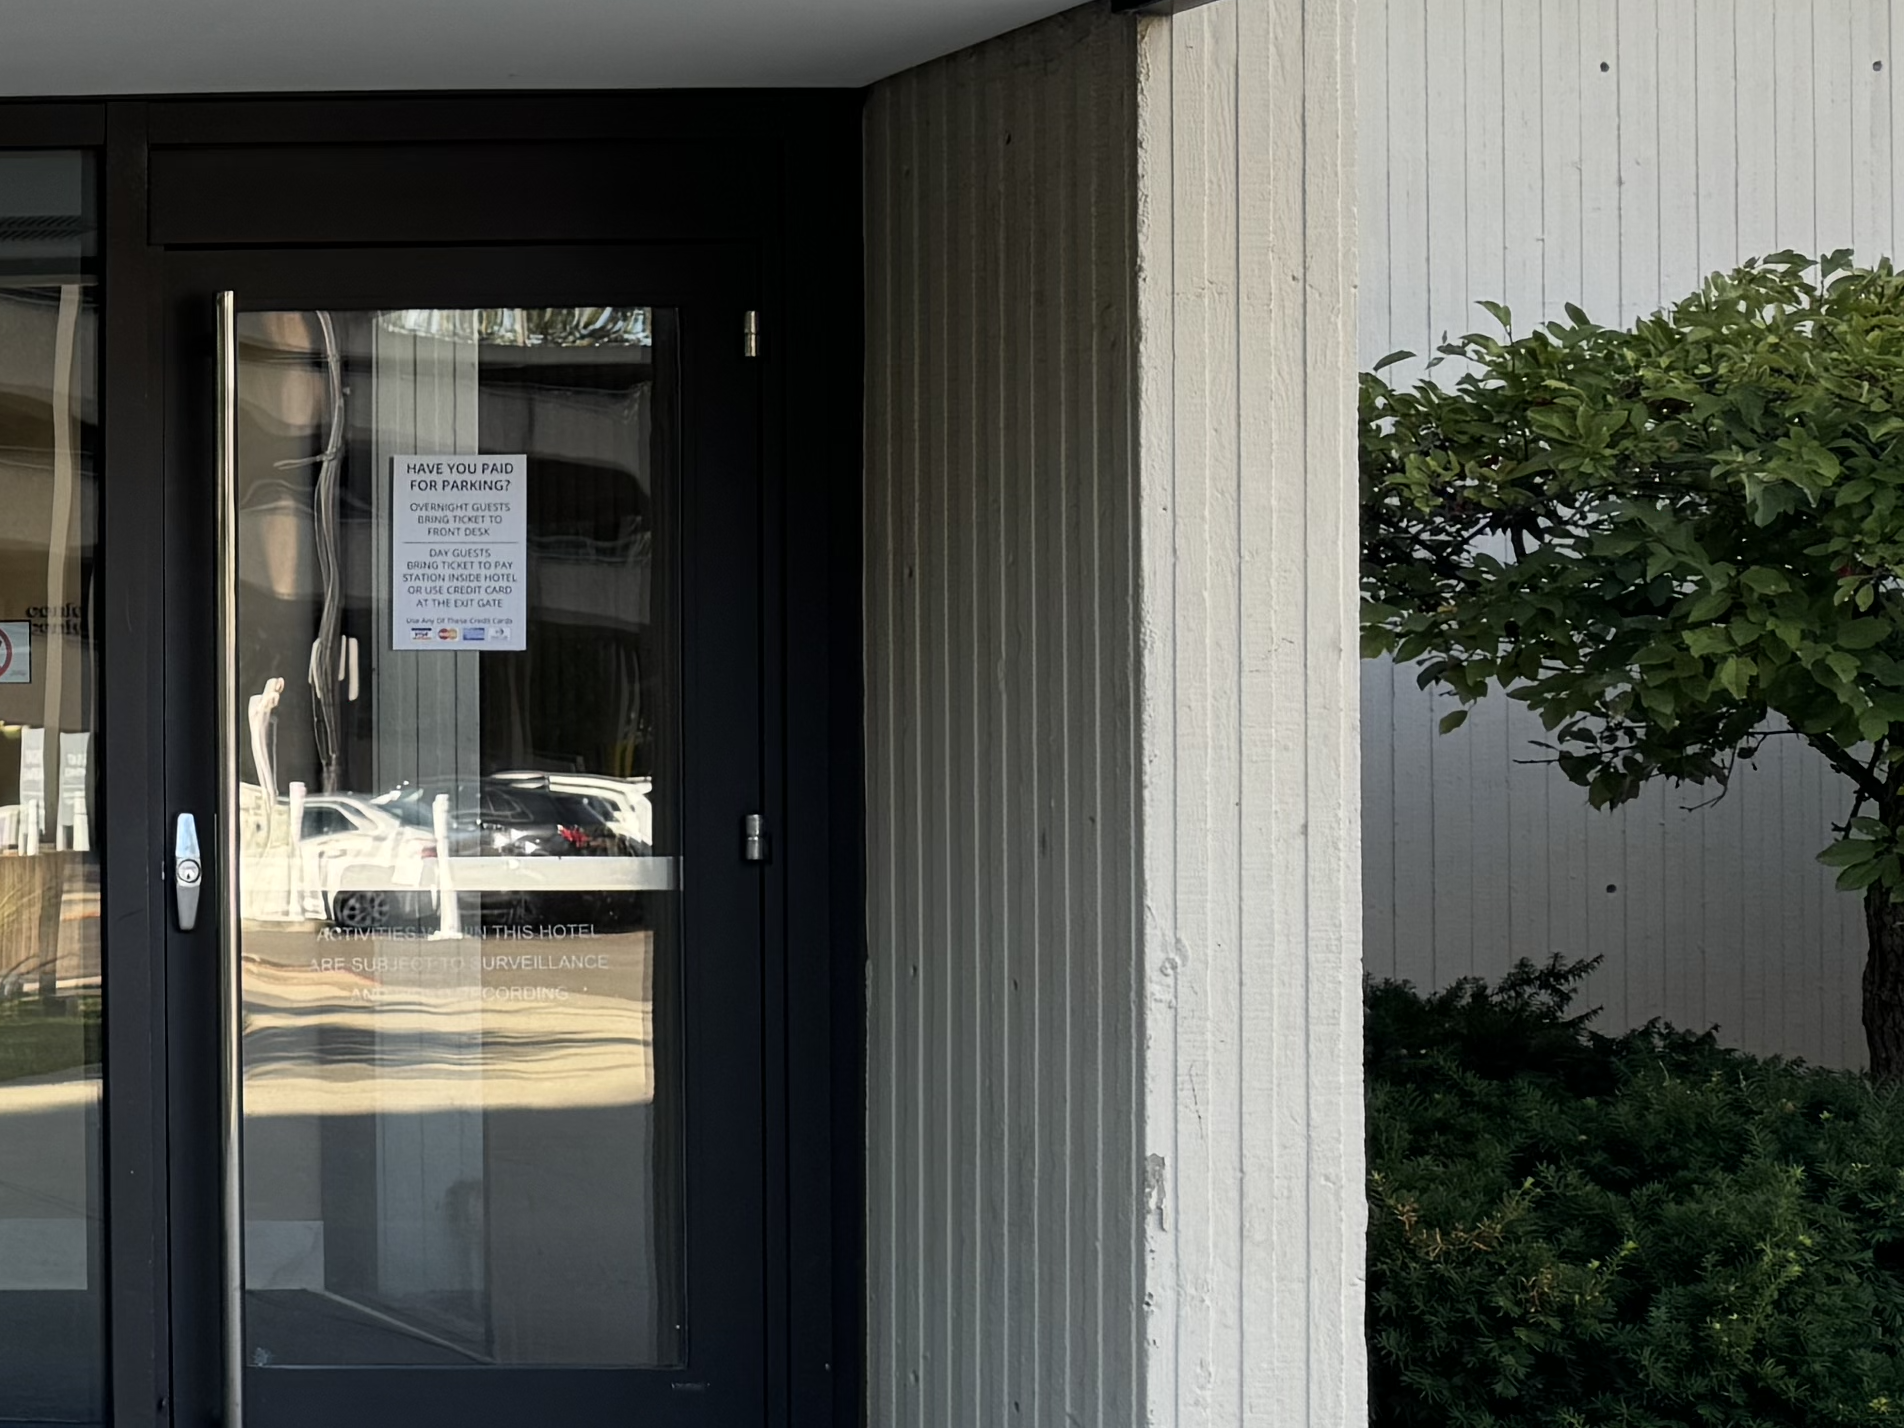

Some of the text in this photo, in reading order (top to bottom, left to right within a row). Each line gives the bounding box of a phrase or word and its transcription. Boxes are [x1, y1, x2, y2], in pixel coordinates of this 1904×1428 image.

[406, 463, 514, 474] HAVE YOU PAID
[410, 480, 512, 491] FOR PARKING?
[410, 502, 510, 512] OVERNIGHT GUESTS
[418, 515, 502, 524] BRING TICKET TO
[428, 527, 490, 536] FRONT DESK
[428, 548, 492, 557] DAY GUESTS
[406, 561, 512, 570] BRING TICKET TO PAY
[402, 574, 518, 582] STATION INSIDE HOTEL
[408, 586, 512, 595] OR USE CREDIT CARD
[416, 599, 502, 608] AT THE EXIT GATE
[316, 926, 416, 942] ACTIVITIES
[492, 925, 534, 940] THIS
[540, 924, 598, 939] HOTEL
[310, 954, 609, 972] ARE SUBJECT TO SURVEILLANCE
